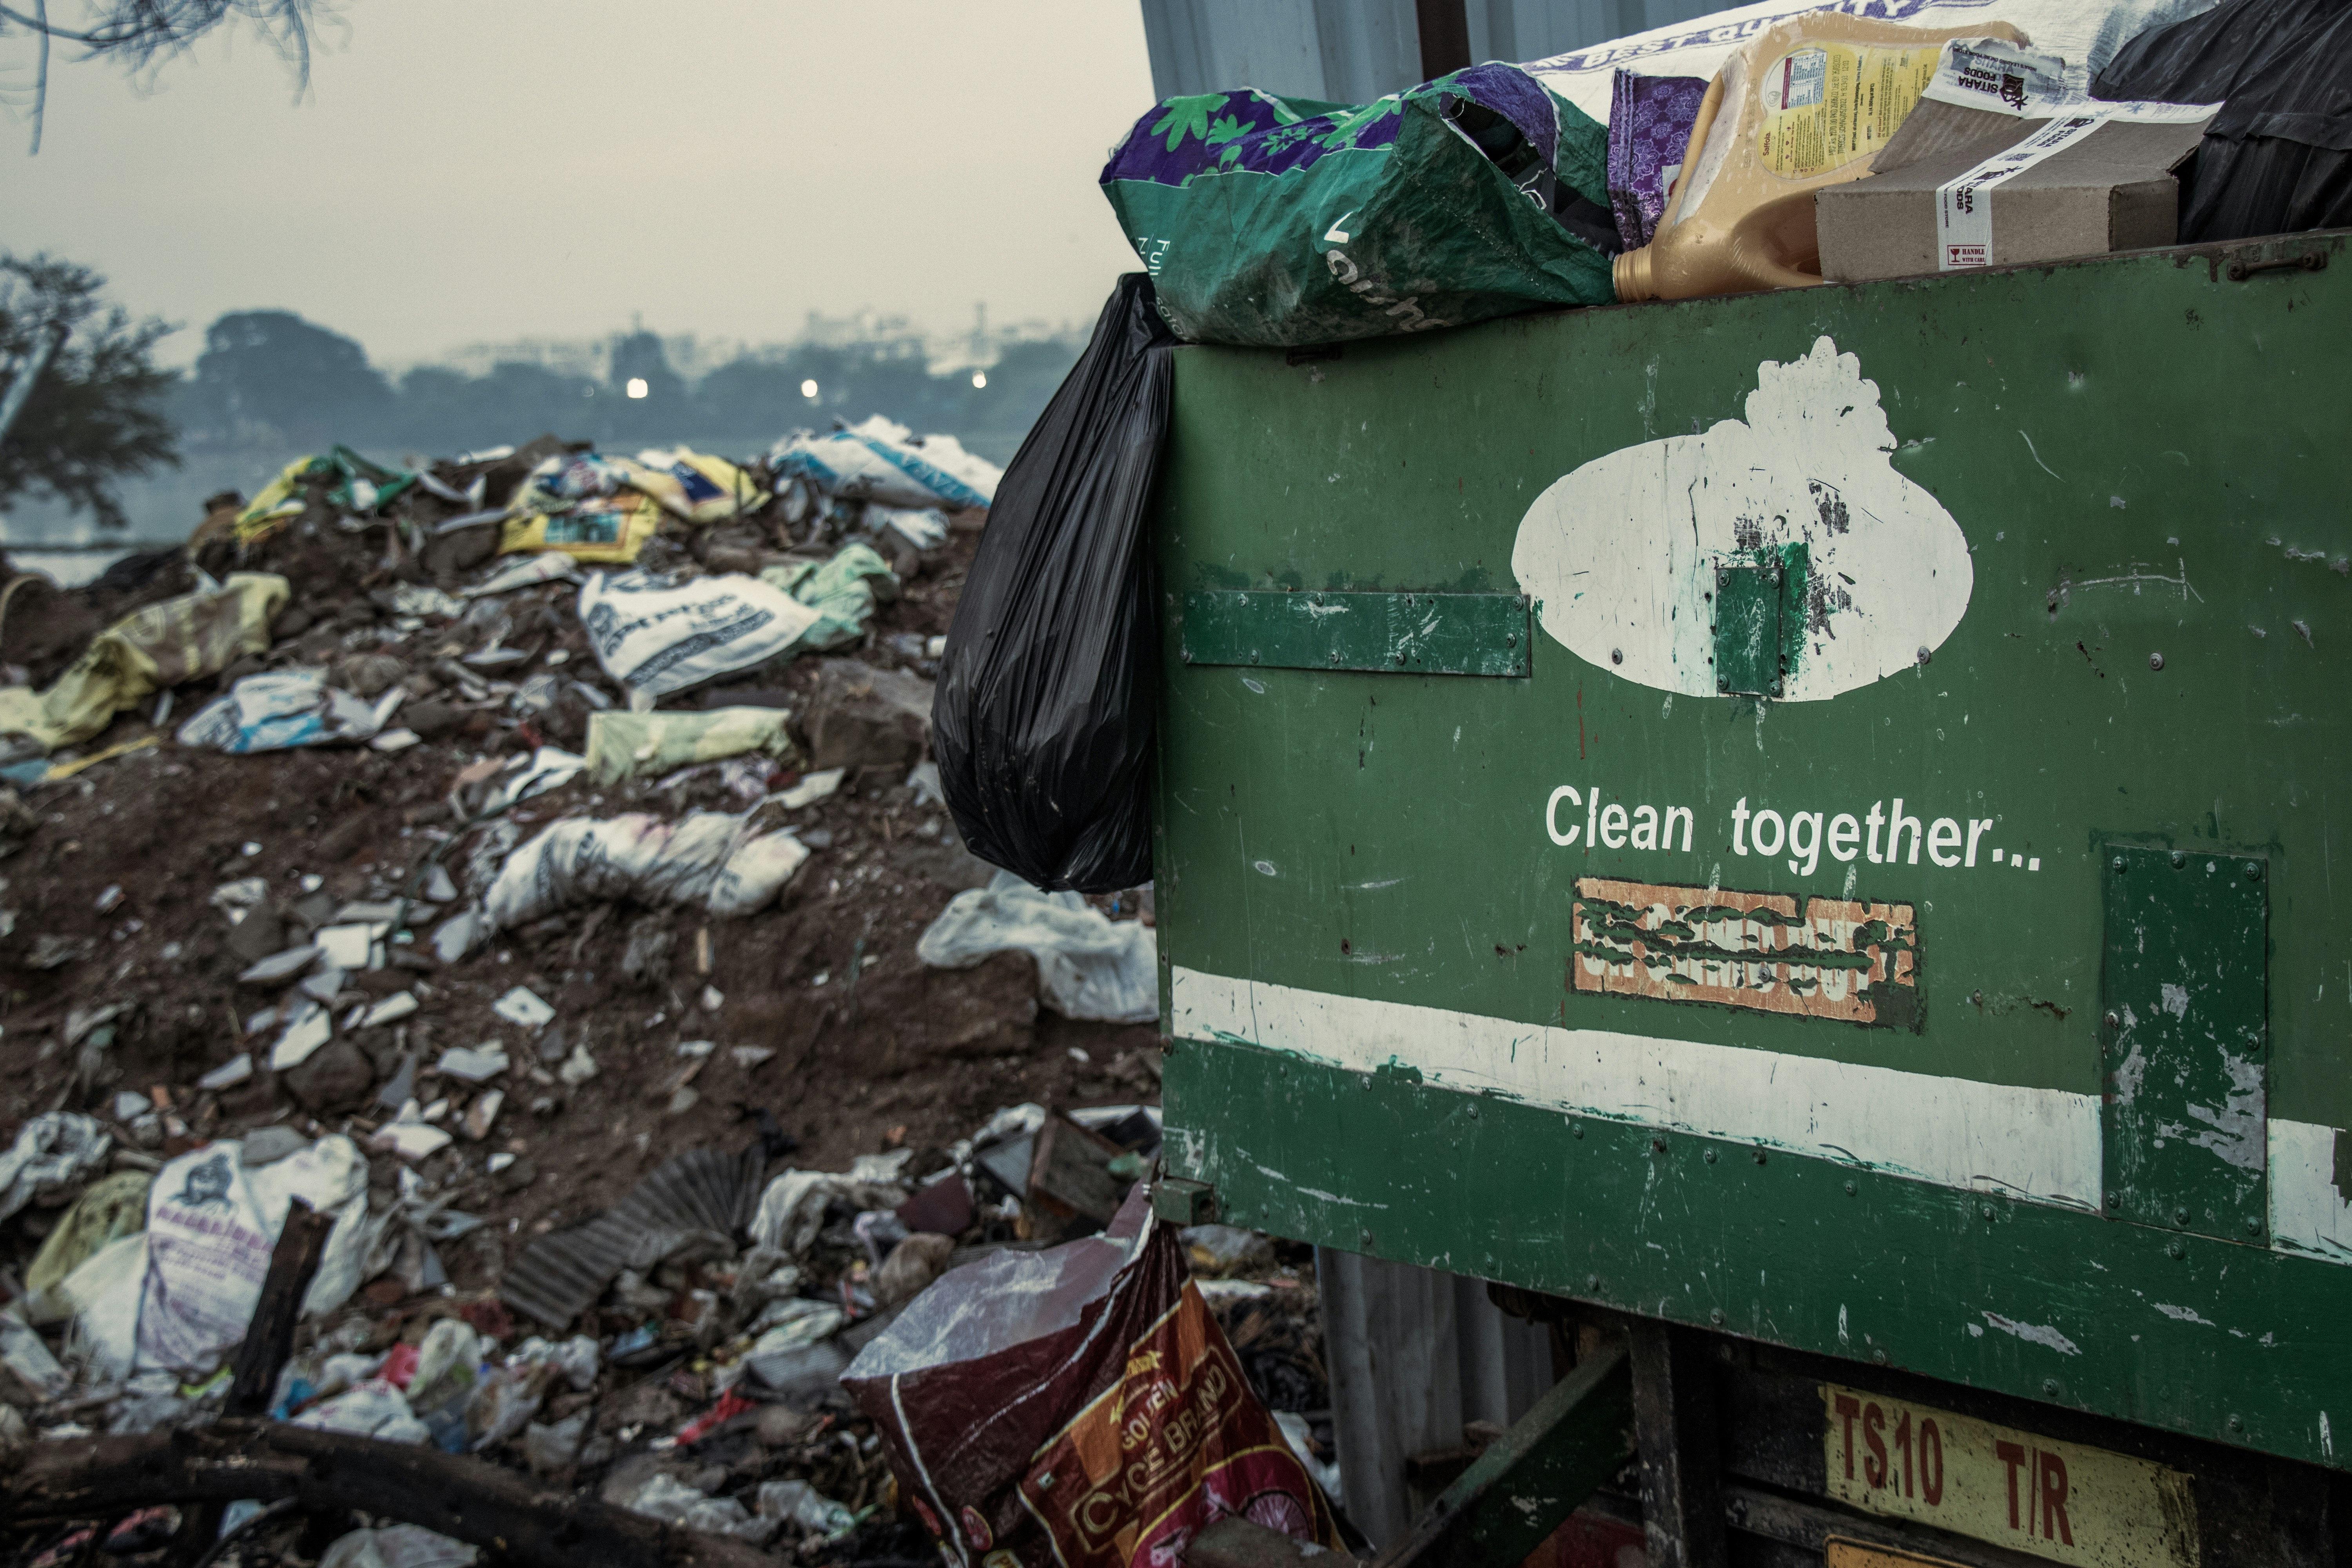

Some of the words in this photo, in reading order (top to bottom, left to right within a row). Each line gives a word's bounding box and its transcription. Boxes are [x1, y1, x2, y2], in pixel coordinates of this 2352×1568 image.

[1581, 32, 1694, 68] BEST
[1708, 0, 1906, 41] QUTY
[1999, 58, 2019, 67] LEADING
[2020, 64, 2037, 72] INDIA'S
[1964, 67, 1996, 82] FOODS
[1958, 76, 1998, 94] SITARA
[2037, 131, 2065, 147] FOODS
[2041, 129, 2077, 148] SITARA
[1545, 785, 1693, 852] Clean
[1732, 797, 2040, 877] together...
[1162, 1364, 1227, 1454] BRAND
[1835, 1394, 1943, 1506] TS10
[1996, 1440, 2074, 1548] T/R
